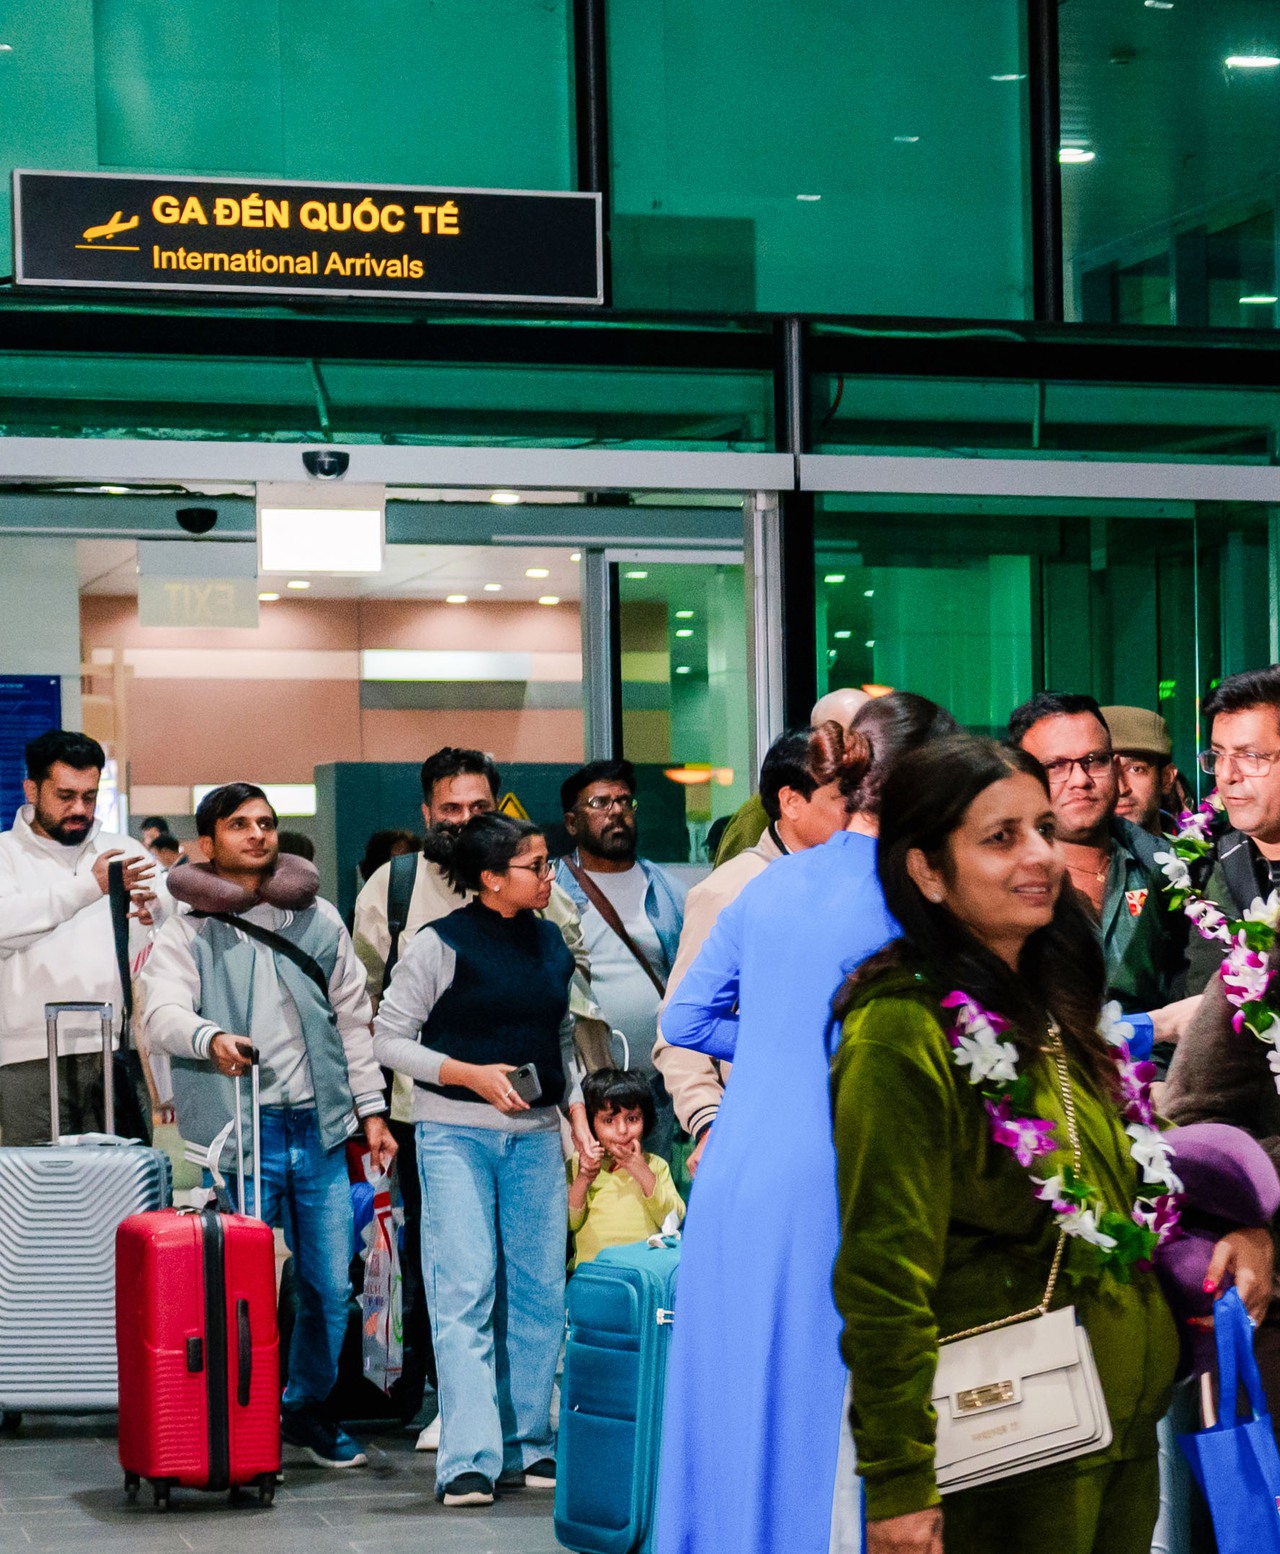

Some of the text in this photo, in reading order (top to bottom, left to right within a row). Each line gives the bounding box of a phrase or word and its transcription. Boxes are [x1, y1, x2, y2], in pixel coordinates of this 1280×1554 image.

[152, 195, 209, 226] GA
[152, 245, 425, 279] International Arrivals
